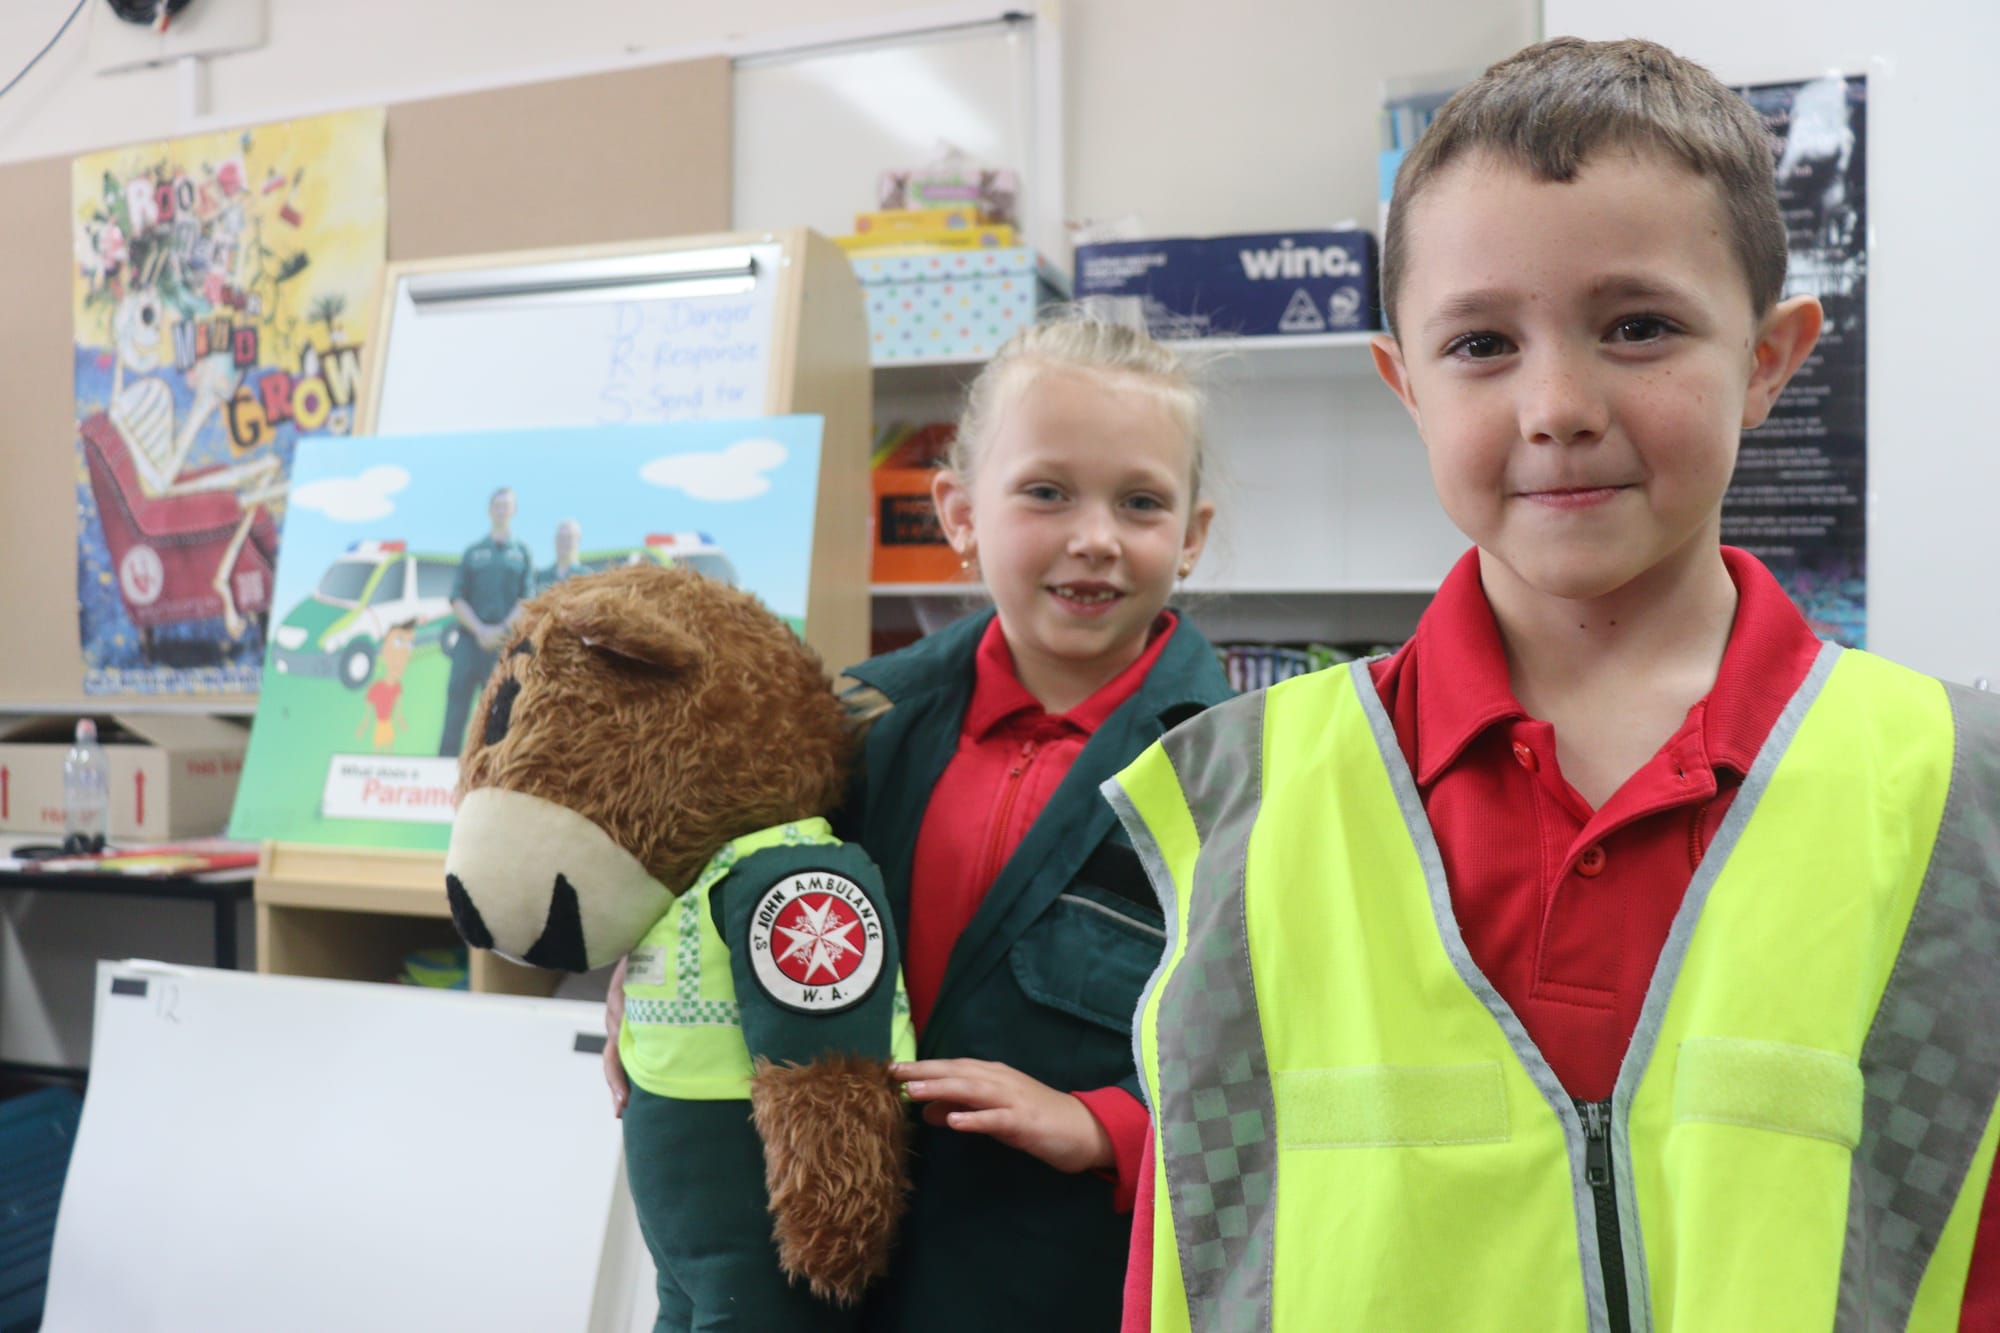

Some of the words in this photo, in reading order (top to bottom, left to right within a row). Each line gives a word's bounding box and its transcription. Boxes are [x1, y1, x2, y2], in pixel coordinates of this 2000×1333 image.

[1240, 238, 1362, 280] winc.
[228, 345, 362, 449] GROW
[758, 890, 786, 931] JOHN
[795, 877, 880, 941] AMBULANCE
